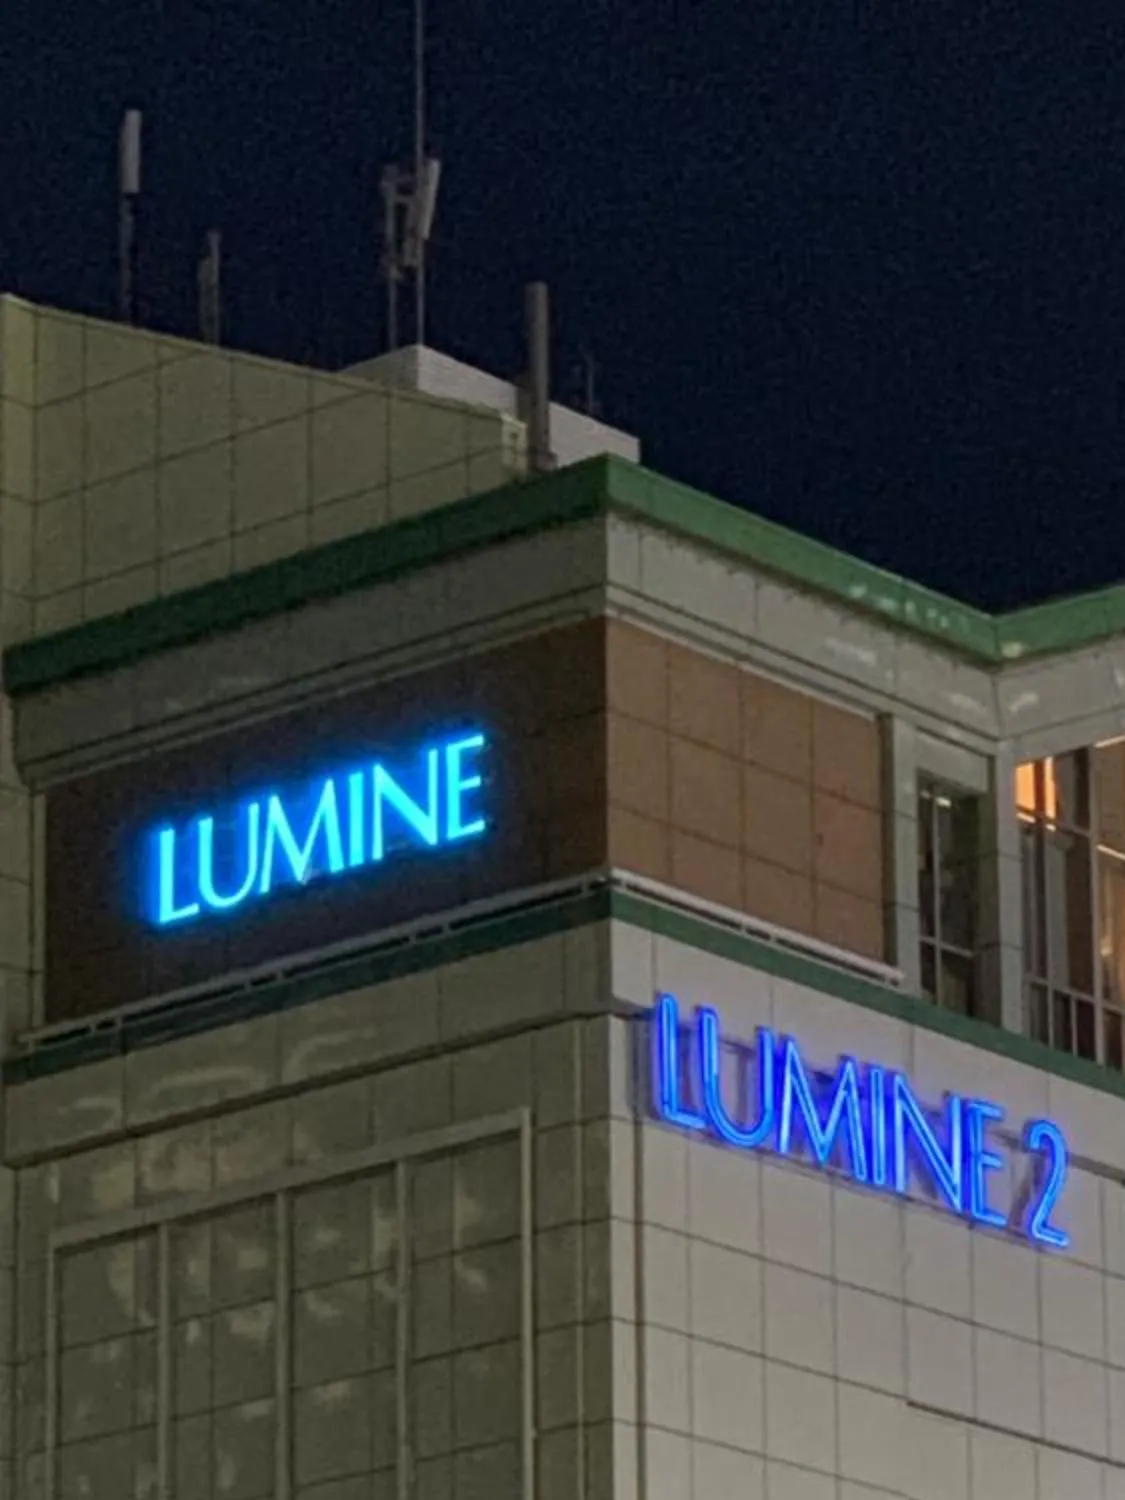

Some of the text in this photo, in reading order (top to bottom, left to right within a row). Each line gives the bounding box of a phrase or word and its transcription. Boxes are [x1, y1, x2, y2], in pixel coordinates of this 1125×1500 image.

[156, 732, 488, 925] LUMINE
[655, 991, 1069, 1248] LUMINE 2
